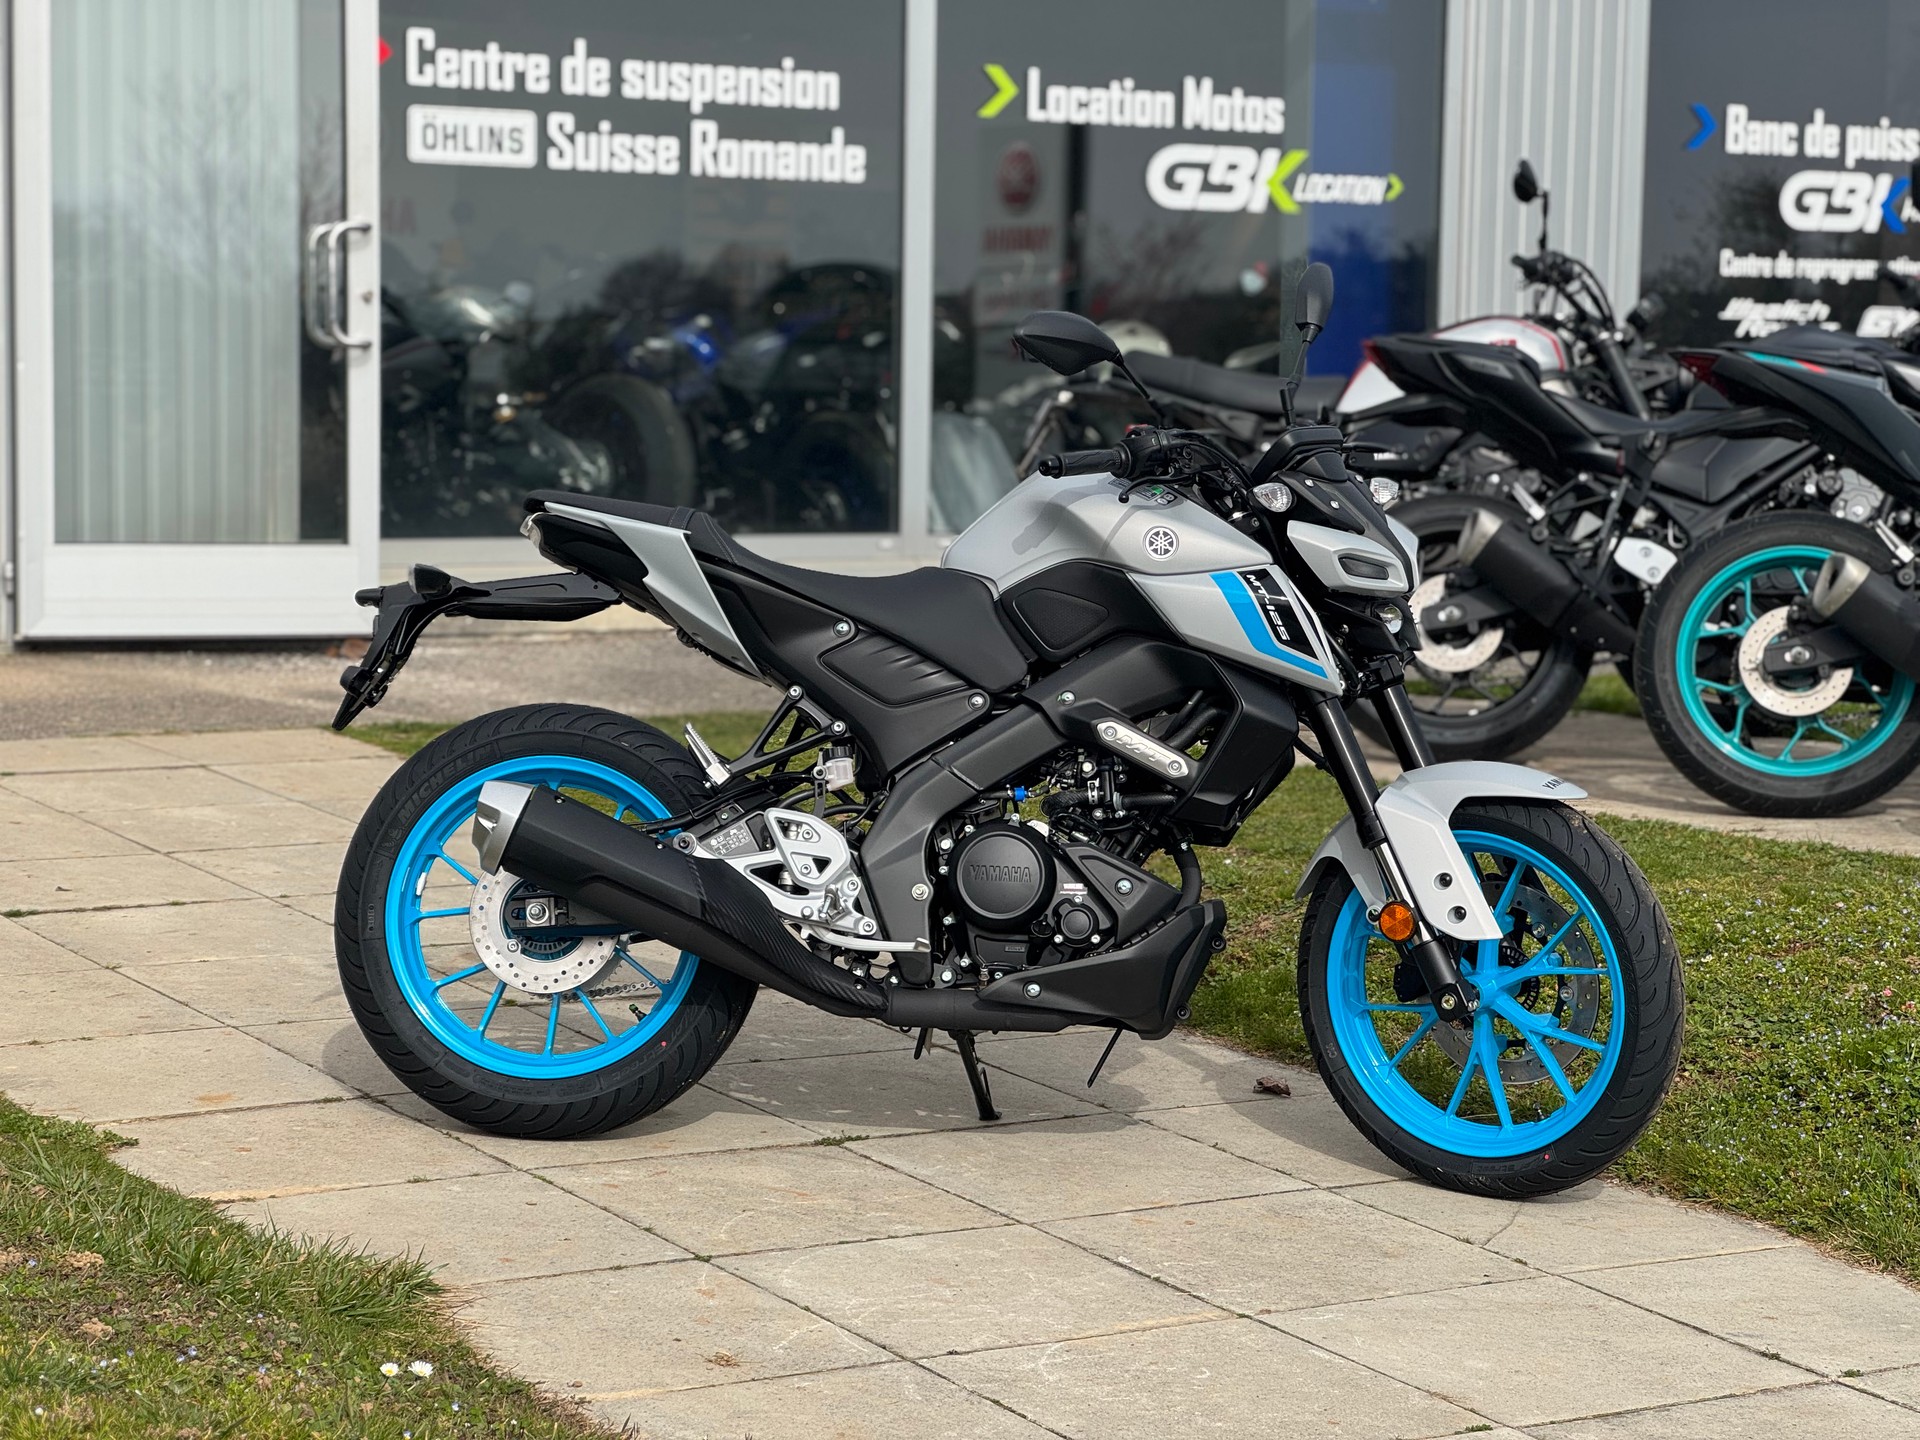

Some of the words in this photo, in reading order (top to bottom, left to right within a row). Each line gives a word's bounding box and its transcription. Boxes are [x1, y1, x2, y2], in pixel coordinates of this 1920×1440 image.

[406, 27, 551, 95] Centre
[561, 37, 611, 98] de
[620, 57, 841, 116] suspension
[1027, 66, 1176, 129] Location
[1183, 75, 1286, 134] Motos
[421, 114, 525, 155] ÖHLINS
[546, 111, 681, 176] Suisse
[689, 119, 867, 184] Romande
[1724, 103, 1799, 157] Banc
[1803, 107, 1841, 159] de
[1293, 172, 1389, 206] LOCATION
[1246, 573, 1291, 642] MT-125
[969, 864, 1032, 883] YAMAHA
